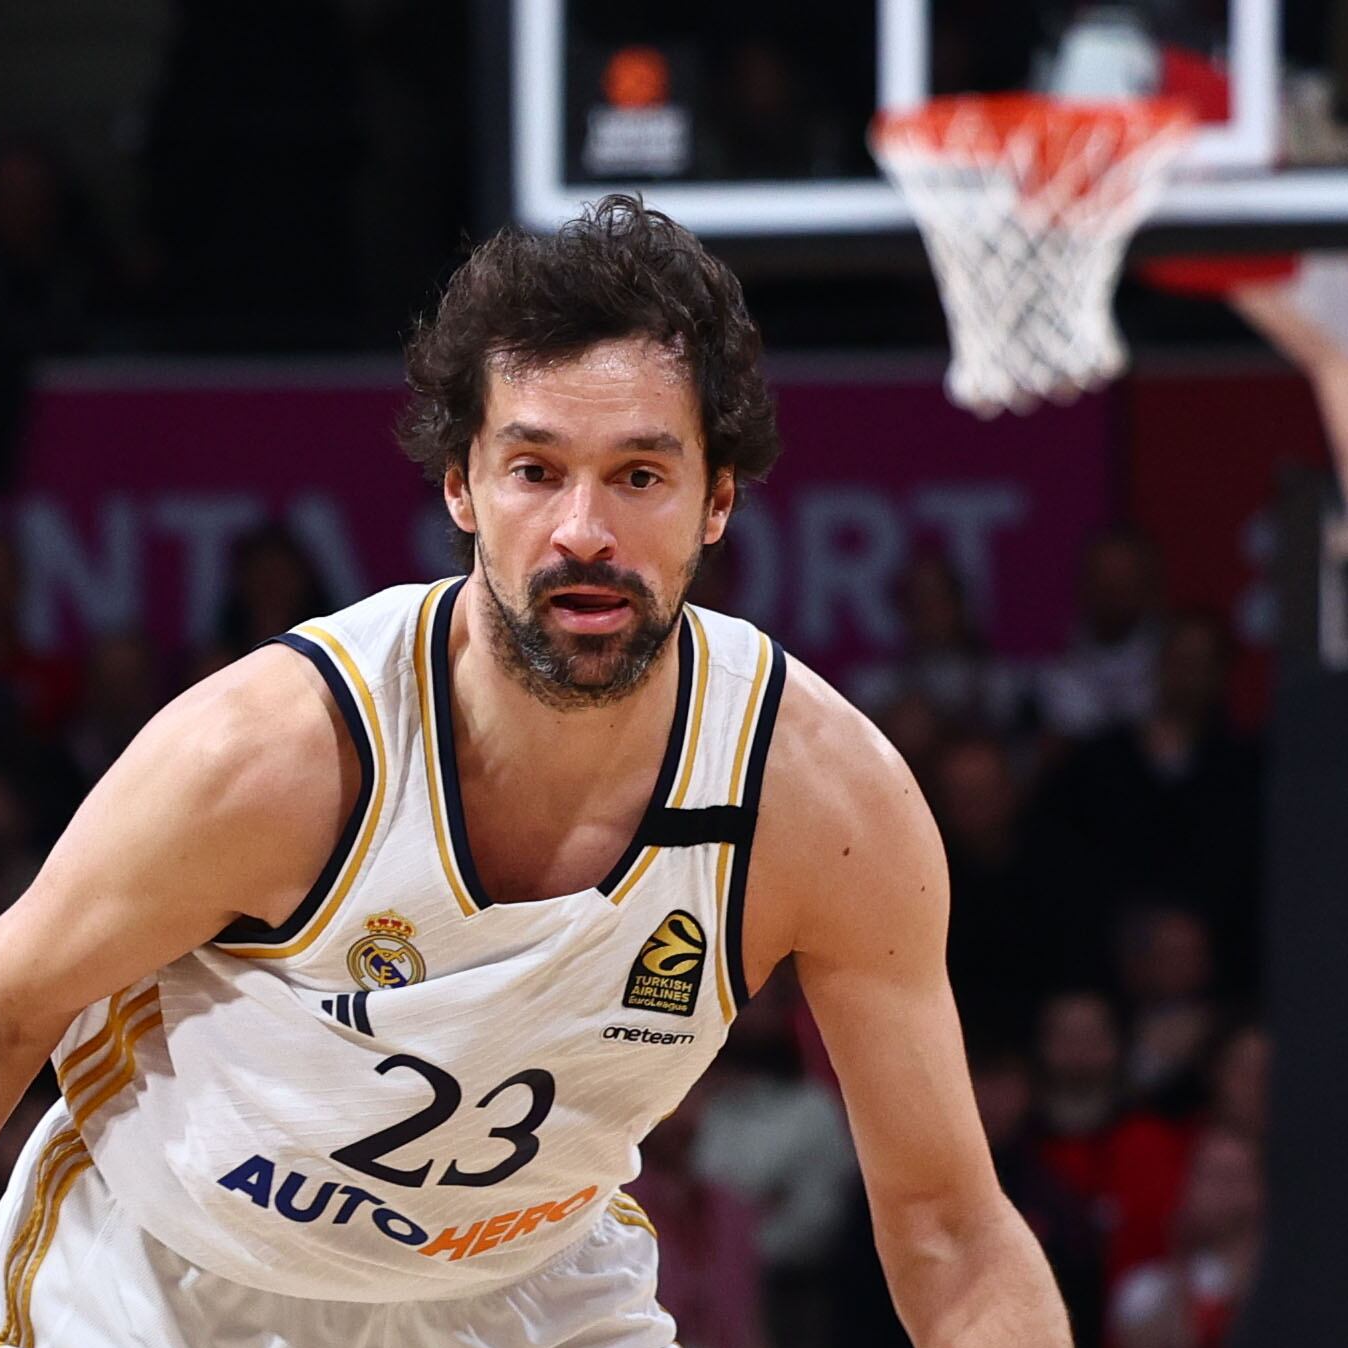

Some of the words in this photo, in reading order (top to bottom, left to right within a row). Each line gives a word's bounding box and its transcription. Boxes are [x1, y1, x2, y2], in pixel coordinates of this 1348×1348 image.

[634, 975, 694, 993] TURKISH
[630, 985, 691, 1003] AIRLINES
[627, 995, 688, 1012] EuroLeague
[603, 1026, 695, 1045] oneteam
[329, 1053, 557, 1189] 23
